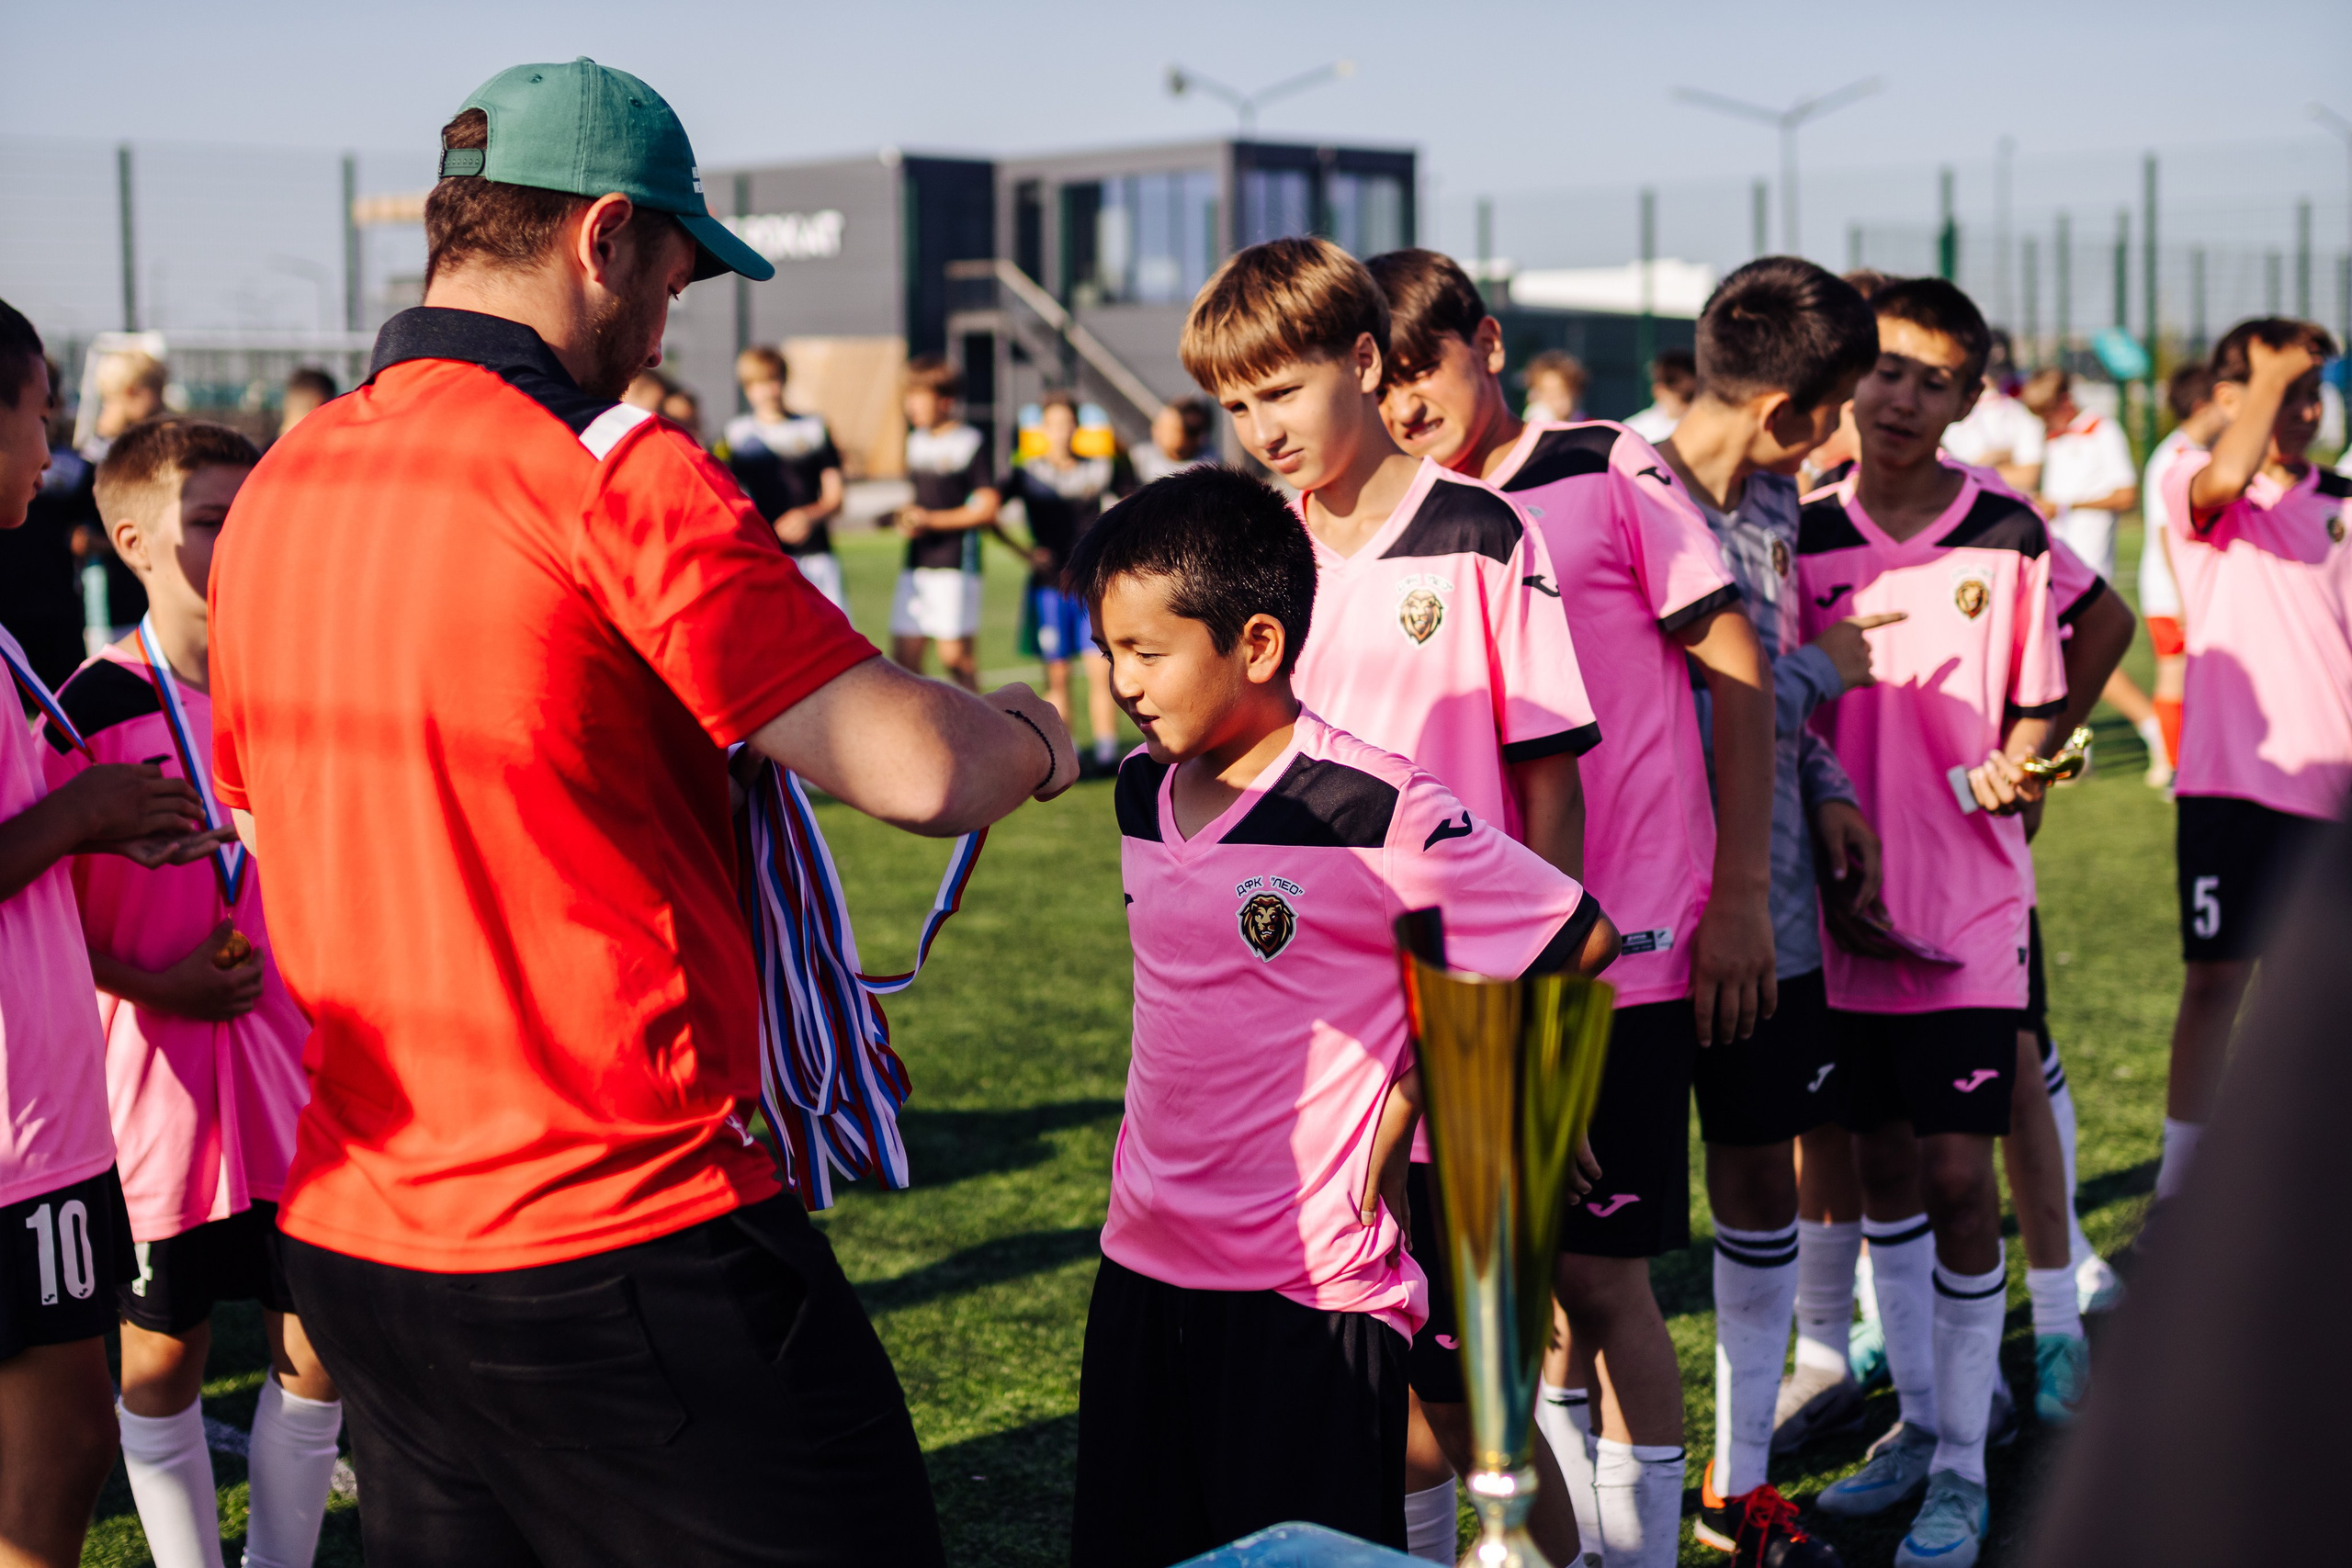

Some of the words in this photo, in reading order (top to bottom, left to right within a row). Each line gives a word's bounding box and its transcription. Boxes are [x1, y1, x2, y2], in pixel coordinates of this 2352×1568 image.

[1236, 877, 1262, 897] ДФК
[1271, 876, 1303, 896] "ЛЕО"
[2193, 875, 2221, 939] 5
[26, 1200, 95, 1305] 10
